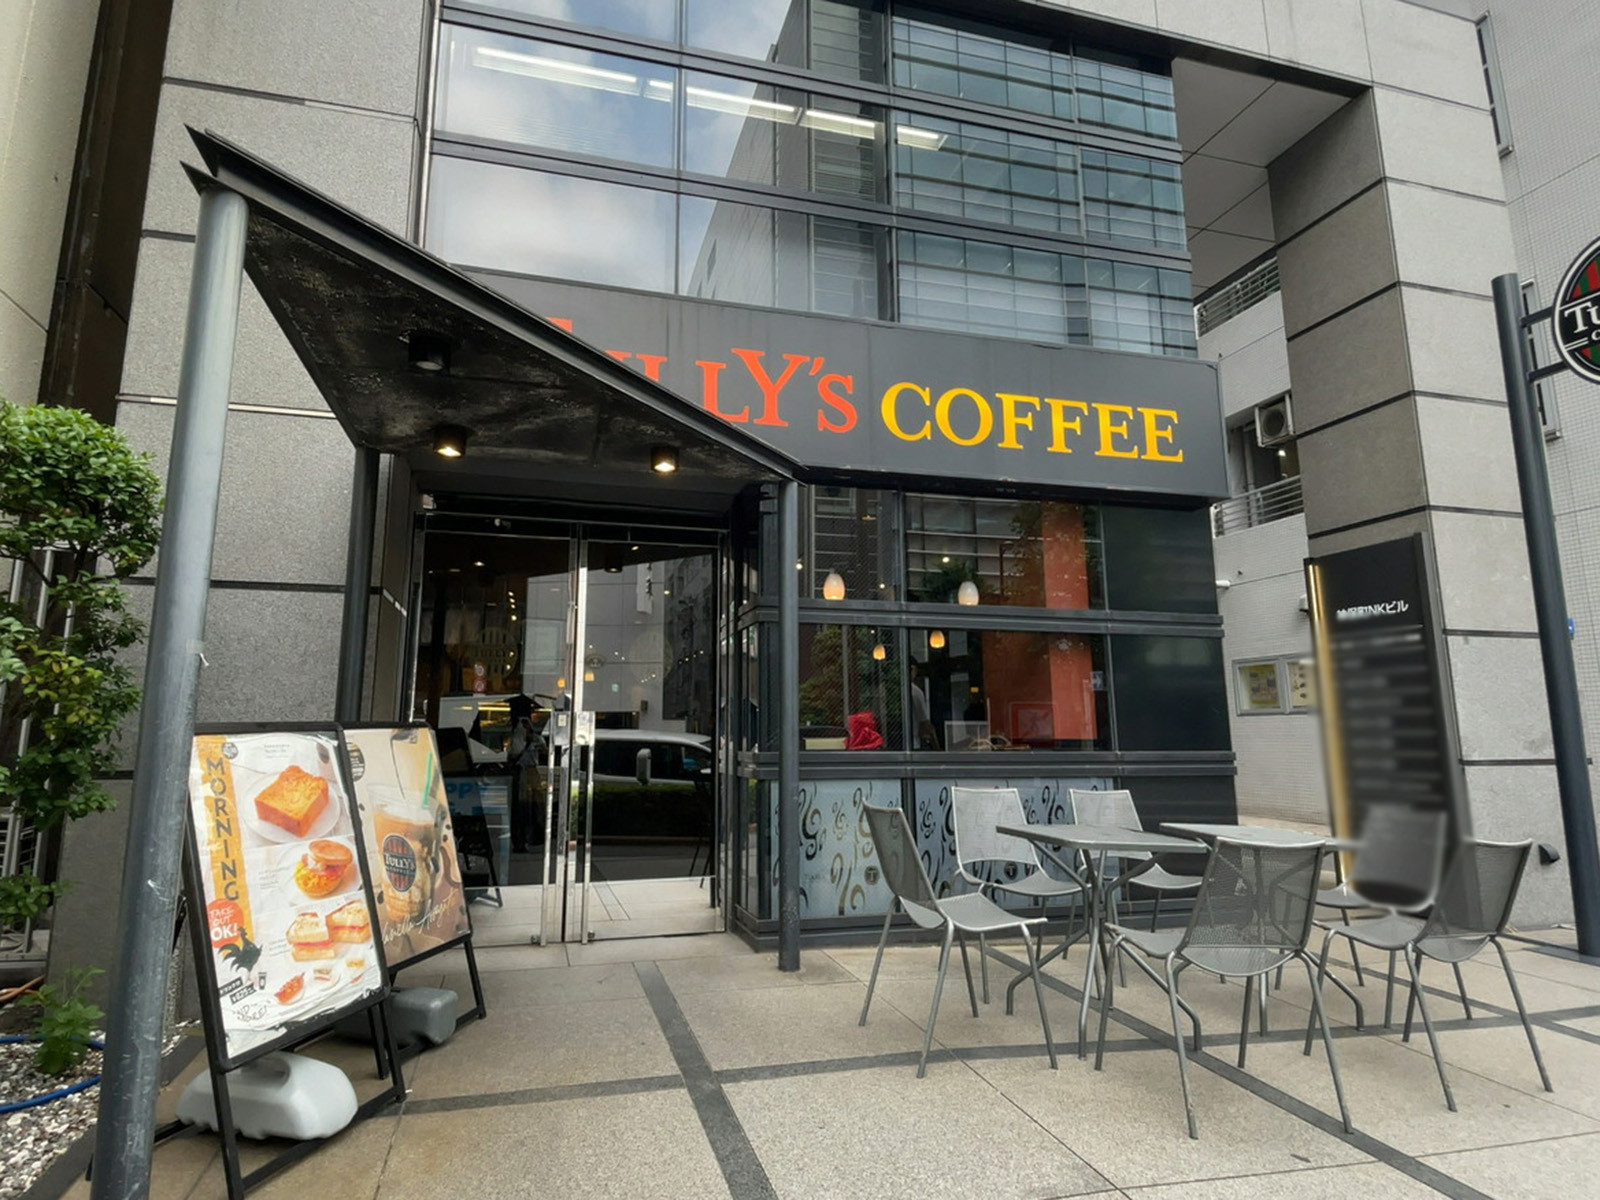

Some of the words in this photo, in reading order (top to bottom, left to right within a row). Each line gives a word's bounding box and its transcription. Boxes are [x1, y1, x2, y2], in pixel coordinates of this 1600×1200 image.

[546, 317, 858, 433] LY'S
[881, 382, 1184, 463] COFFEE
[206, 757, 240, 901] MORNING
[210, 922, 238, 942] OK!
